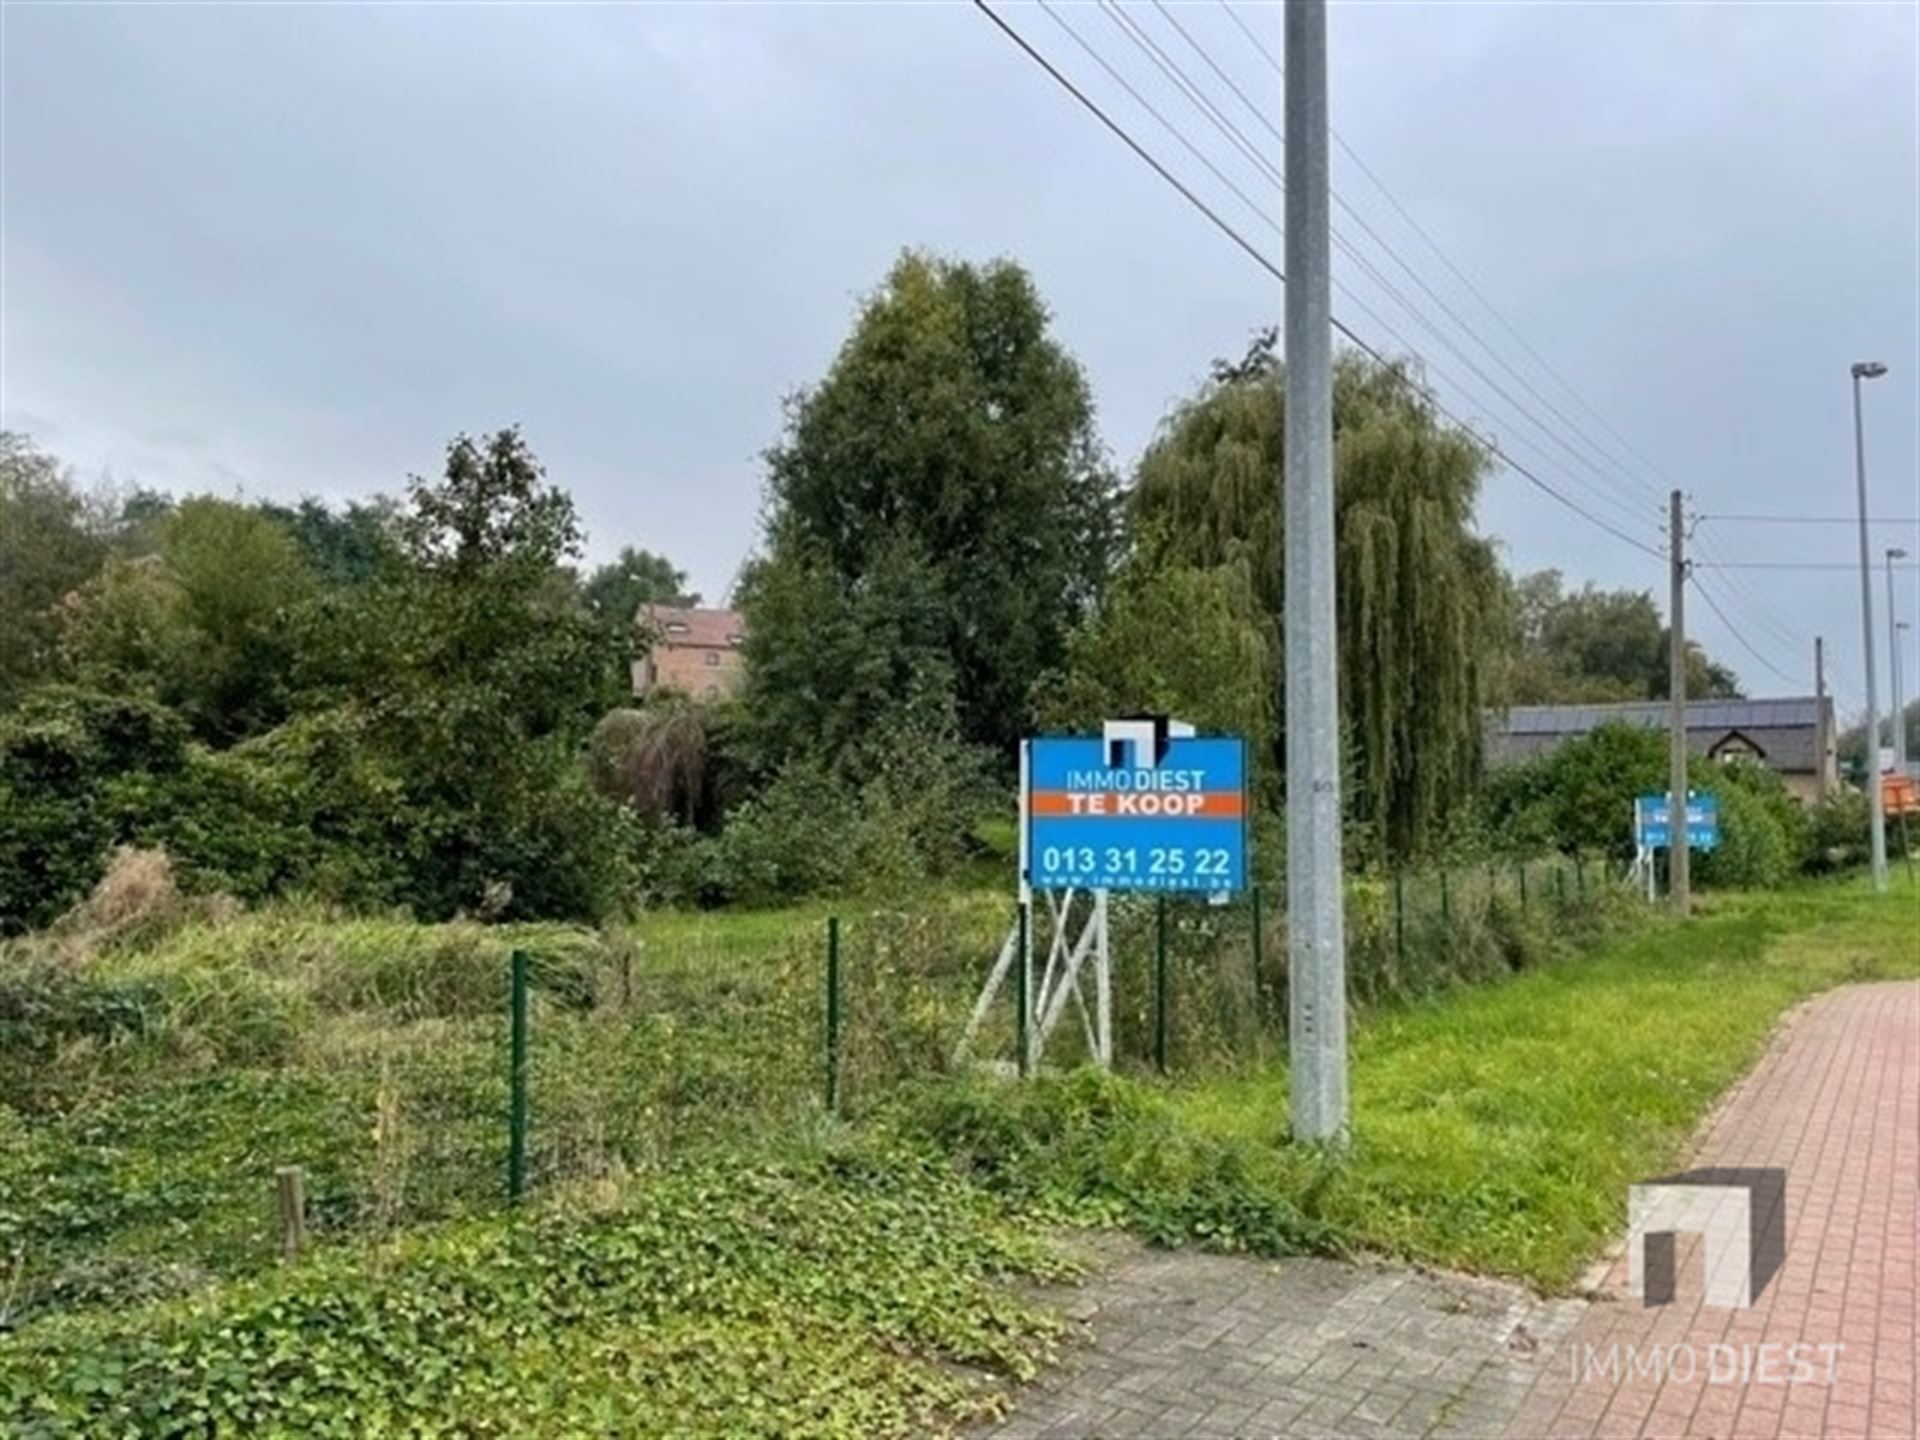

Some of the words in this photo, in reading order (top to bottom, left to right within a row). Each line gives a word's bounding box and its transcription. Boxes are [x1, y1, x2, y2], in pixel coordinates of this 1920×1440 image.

[1067, 793, 1106, 814] TE
[1117, 793, 1205, 815] KOOP
[1043, 847, 1096, 873] 013
[1105, 848, 1137, 873] 31
[1149, 848, 1185, 874] 25
[1194, 848, 1231, 875] 22
